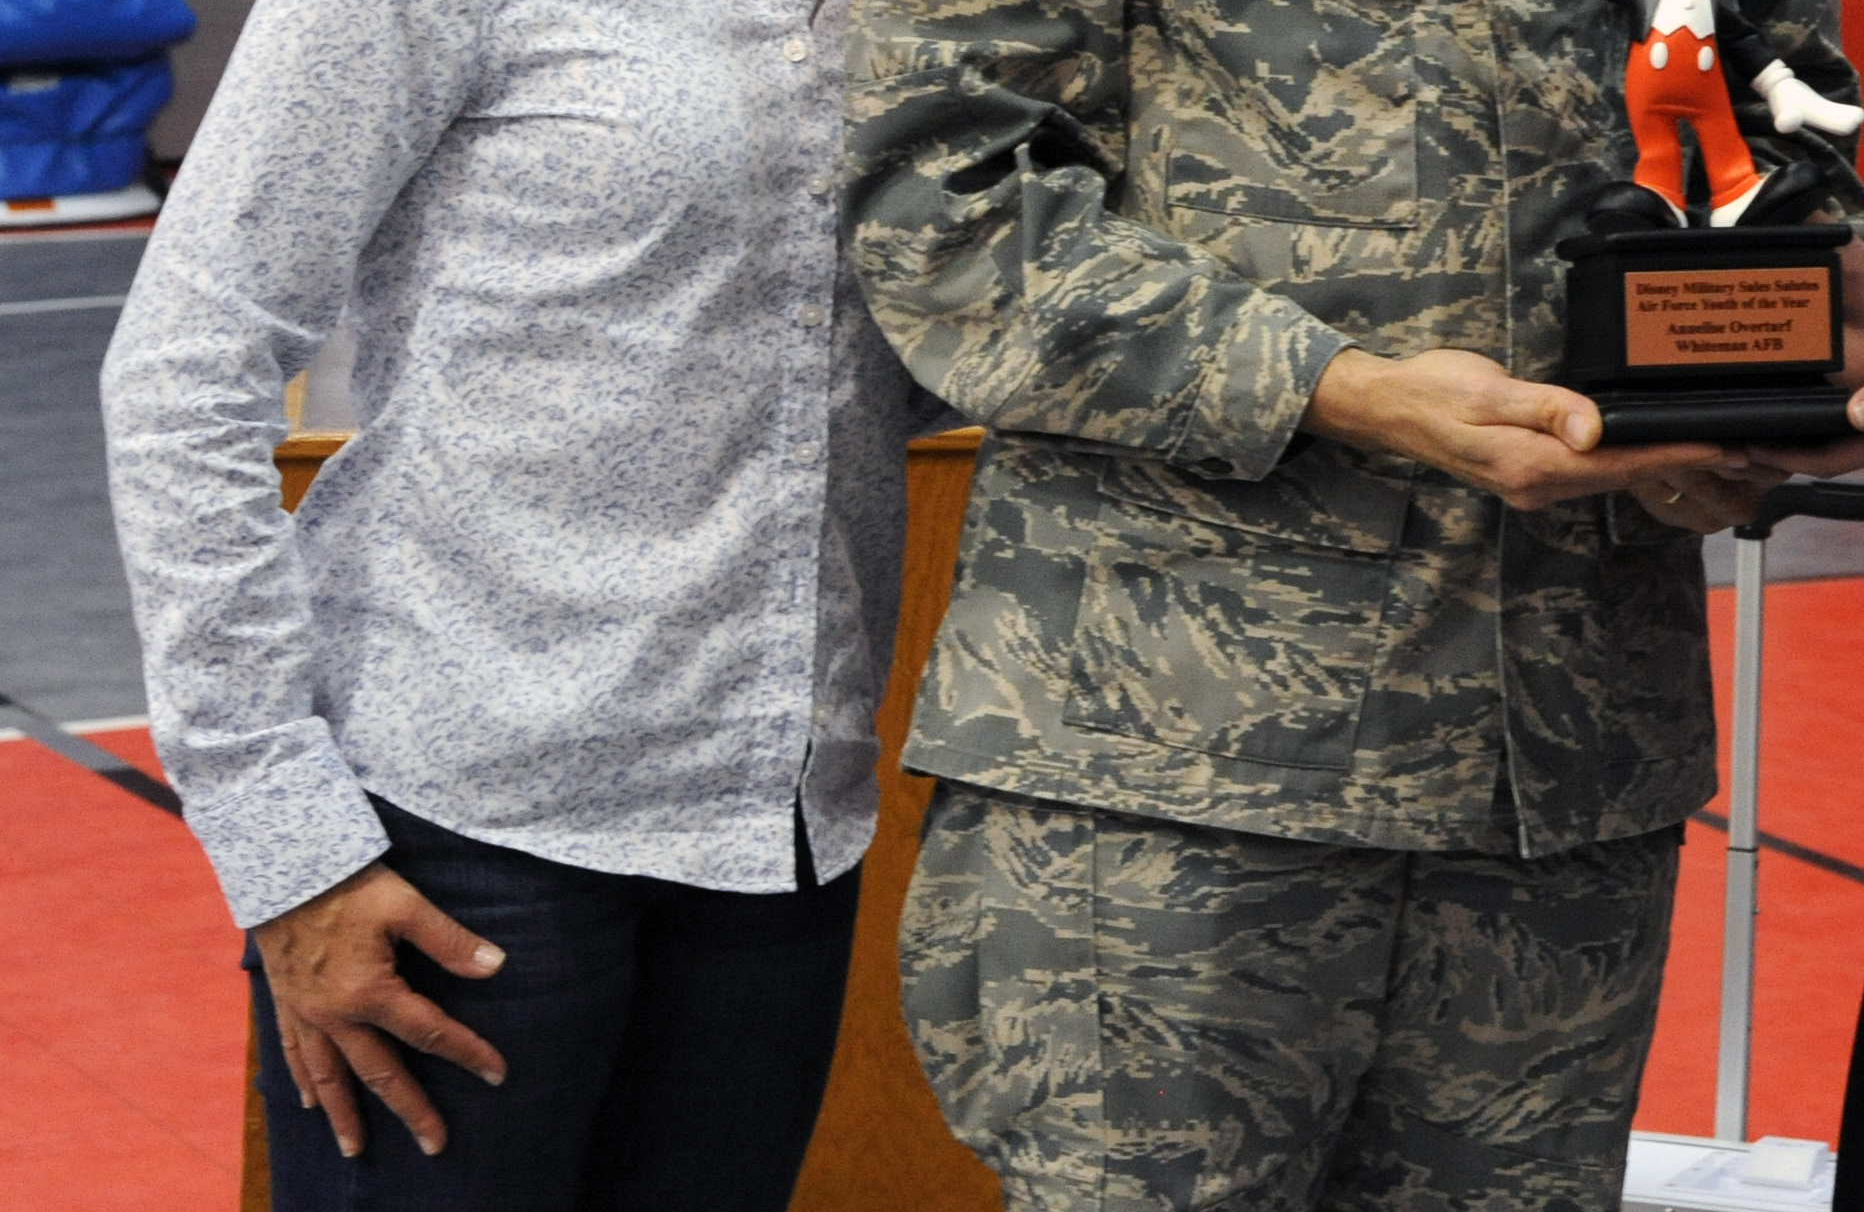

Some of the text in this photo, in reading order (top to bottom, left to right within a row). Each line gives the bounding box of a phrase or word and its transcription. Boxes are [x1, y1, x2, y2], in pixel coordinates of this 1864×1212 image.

[1635, 283, 1680, 297] Disney
[1683, 282, 1735, 296] Military
[1738, 281, 1772, 293] Sales
[1637, 296, 1811, 312] Air Force Youth of the Year
[1728, 319, 1794, 334] Overturf
[1675, 337, 1785, 353] Whiteman AFB
